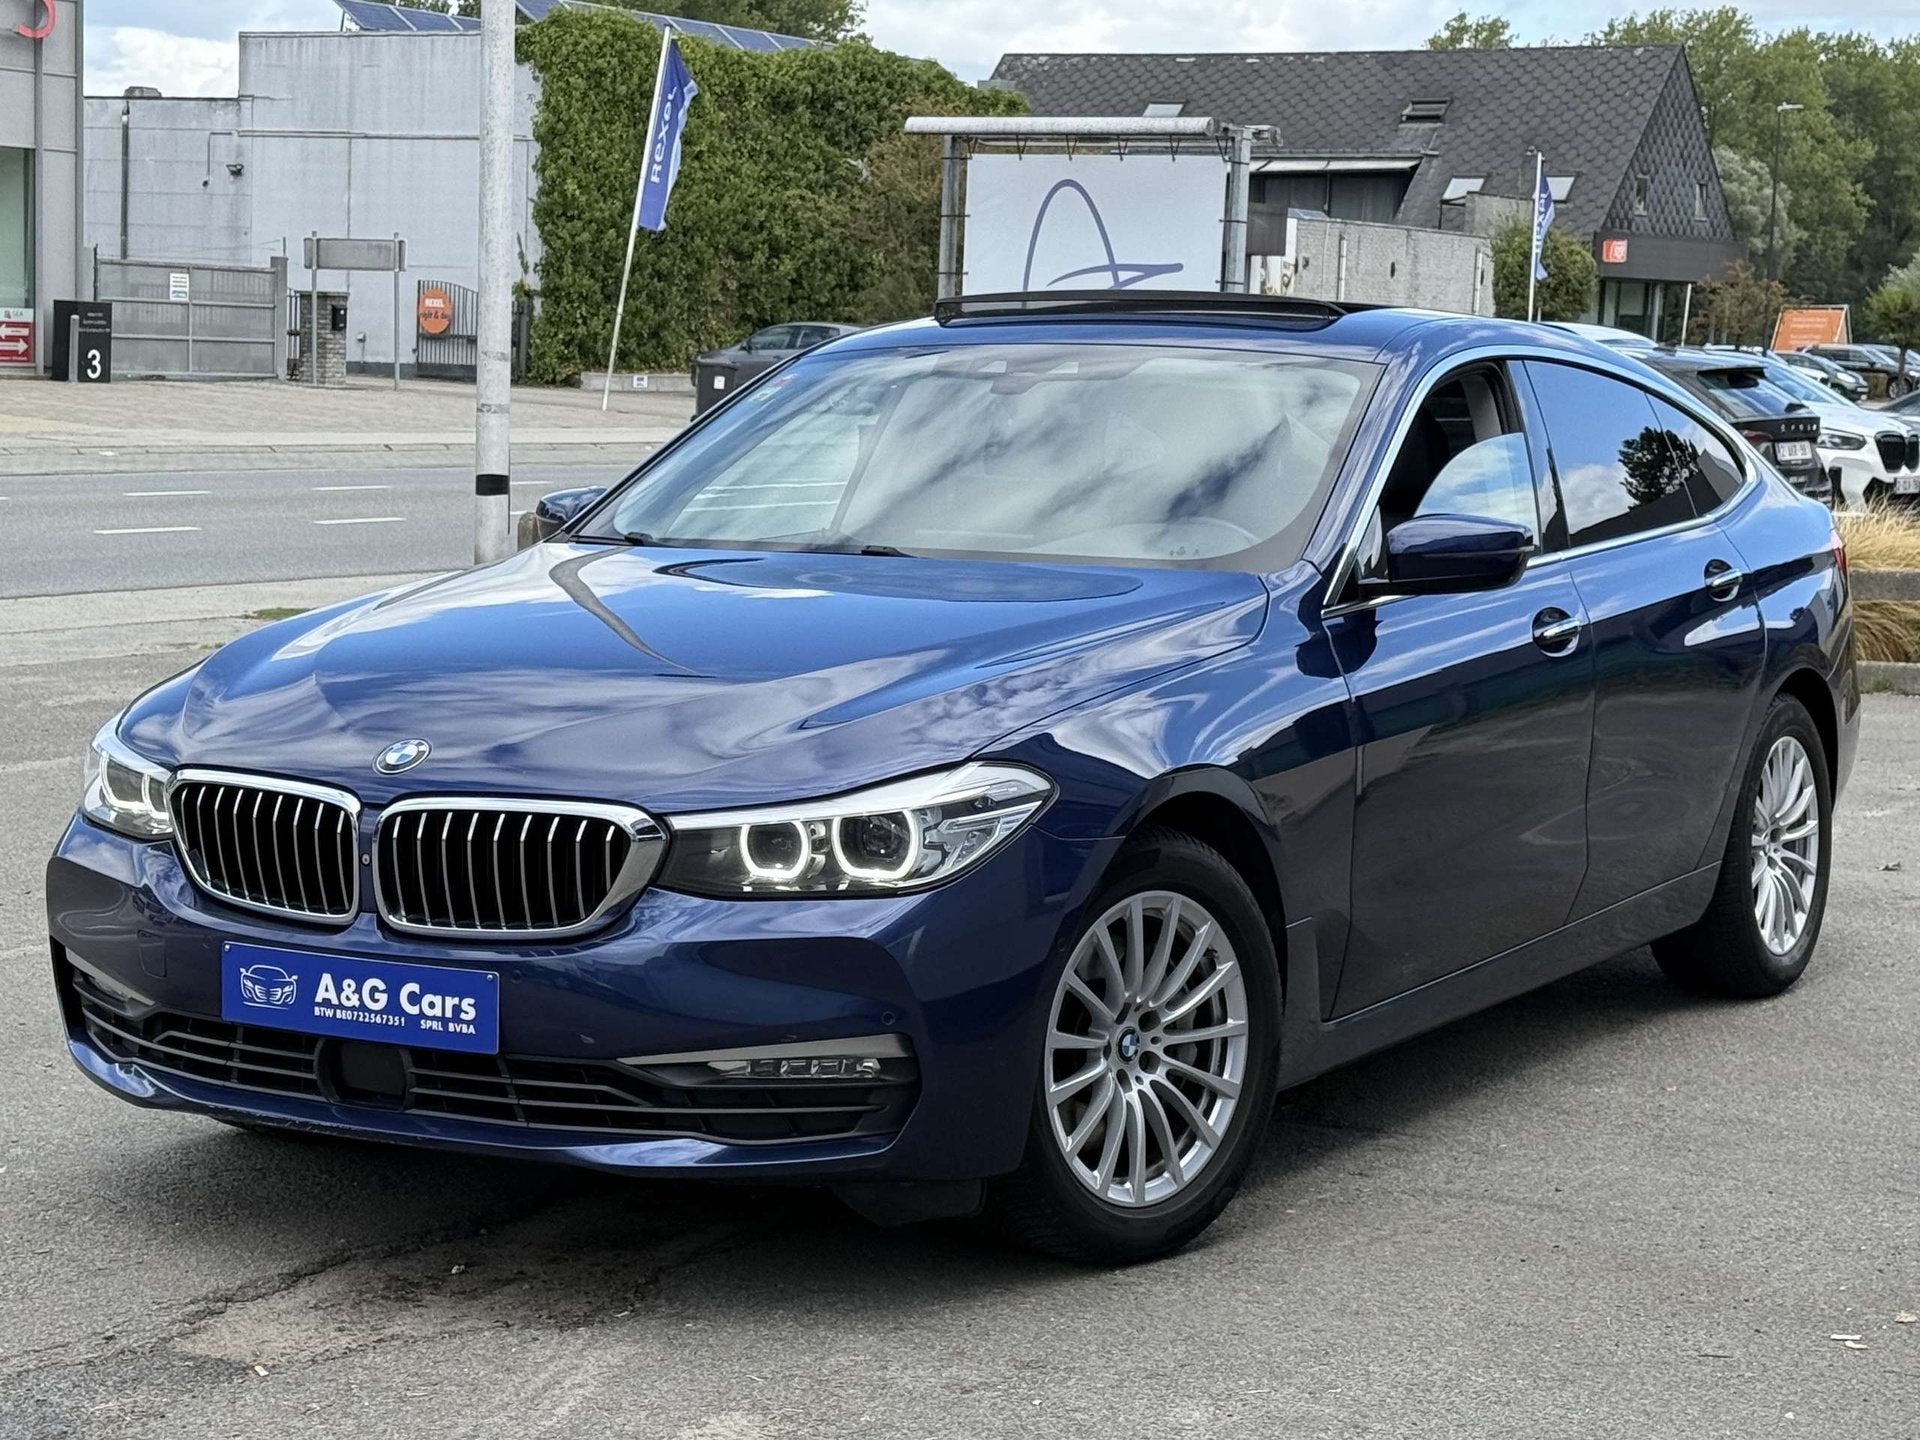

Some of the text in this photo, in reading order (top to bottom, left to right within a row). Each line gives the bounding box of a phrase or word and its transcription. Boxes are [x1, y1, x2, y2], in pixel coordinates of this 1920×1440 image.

[87, 349, 101, 379] 3
[314, 972, 476, 1021] A&G Cars
[314, 1006, 476, 1035] BTW BE0722567351 SPRL BVBA
